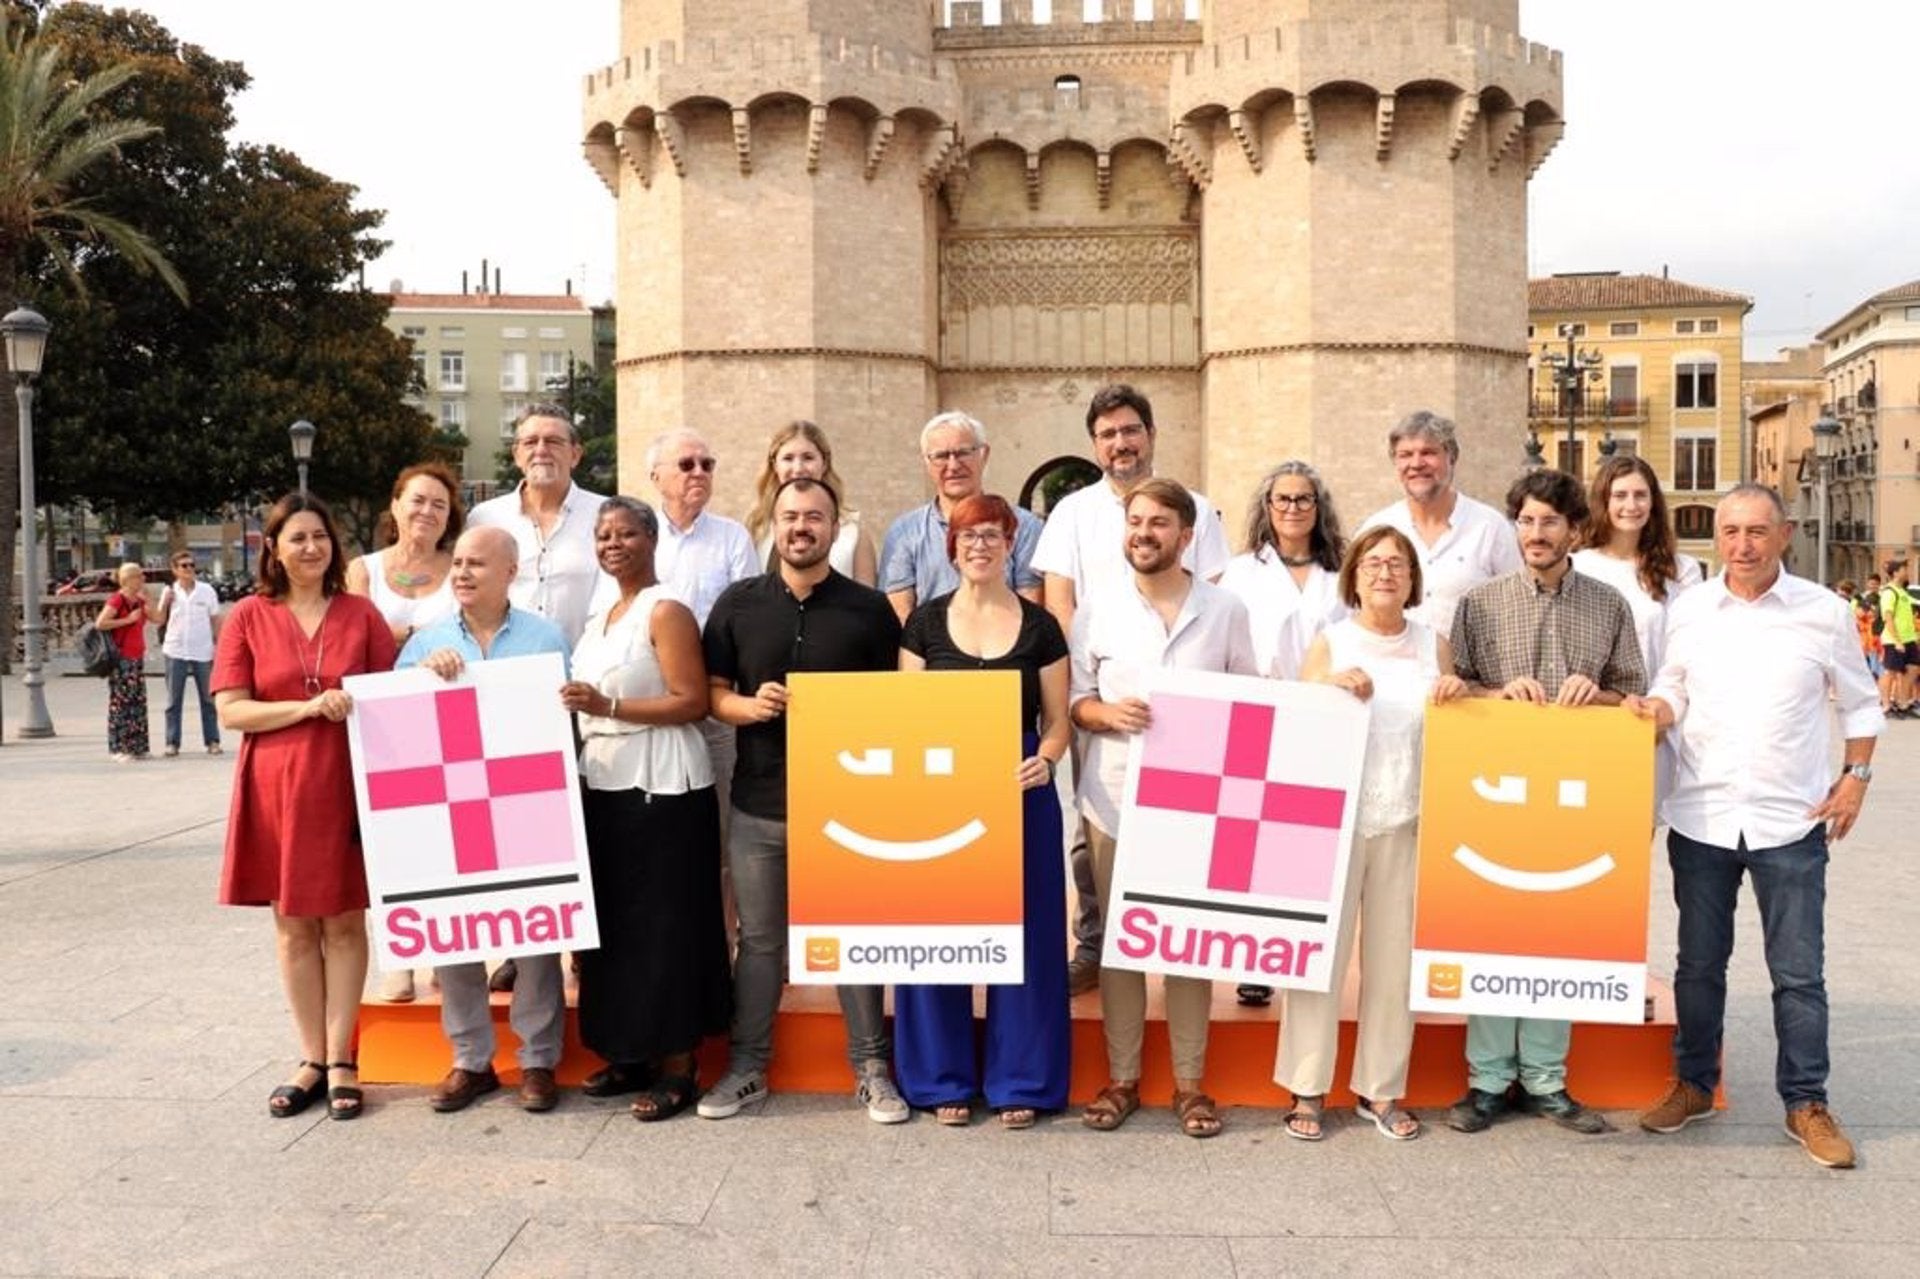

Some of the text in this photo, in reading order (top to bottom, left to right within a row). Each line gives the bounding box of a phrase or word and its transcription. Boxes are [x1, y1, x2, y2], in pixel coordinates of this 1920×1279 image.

[386, 903, 581, 958] Sumar
[1117, 907, 1321, 977] Sumar
[847, 938, 1008, 974] compromís
[1470, 974, 1629, 1005] compromís
